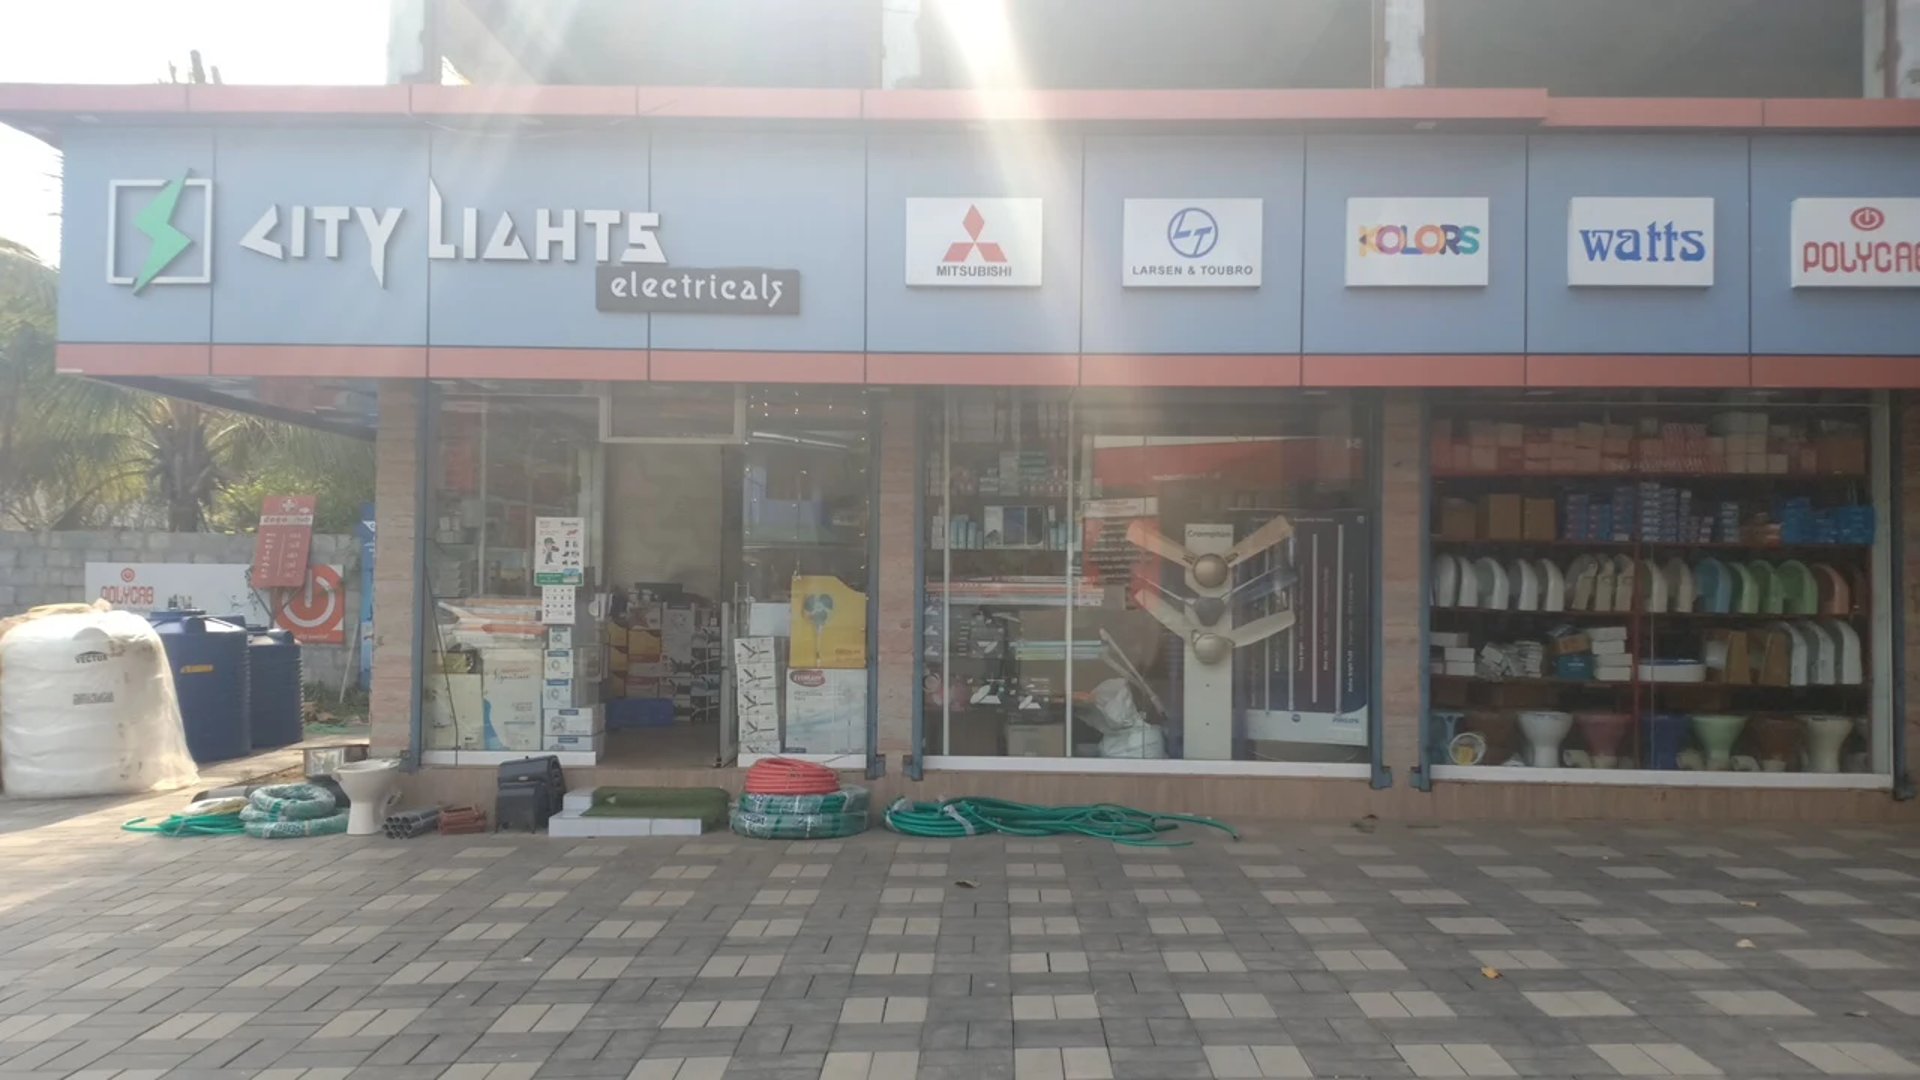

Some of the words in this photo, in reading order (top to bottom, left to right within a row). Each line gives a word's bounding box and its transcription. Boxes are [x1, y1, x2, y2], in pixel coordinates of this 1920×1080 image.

[238, 203, 404, 290] CITY
[1358, 224, 1481, 257] KOLORS
[1579, 220, 1706, 263] watts
[936, 265, 1012, 277] MITSUBISHI
[1132, 265, 1183, 276] LARSEN
[1187, 265, 1196, 276] &
[1200, 265, 1254, 276] TOUBRO
[610, 270, 784, 308] electricals
